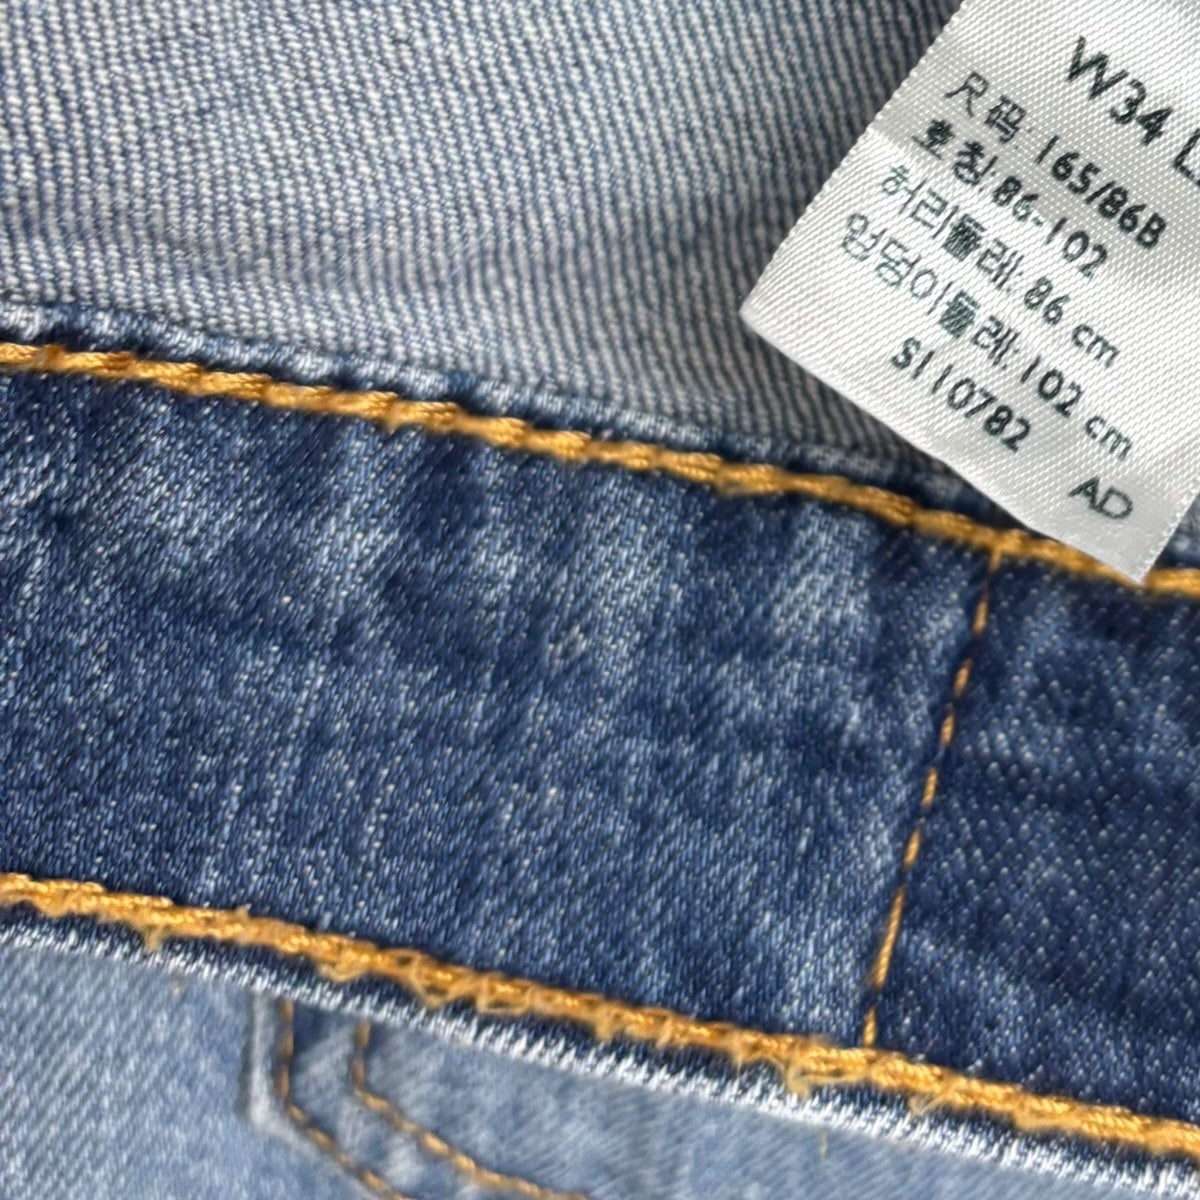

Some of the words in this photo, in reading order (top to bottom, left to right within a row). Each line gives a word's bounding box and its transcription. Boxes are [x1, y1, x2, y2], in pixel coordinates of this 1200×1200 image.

[1066, 34, 1174, 147] W34
[1035, 134, 1168, 251] 165/86B
[1023, 276, 1072, 327] 86
[1070, 323, 1122, 369] cm
[889, 335, 1033, 454] S110782
[1019, 354, 1085, 418] 102
[1084, 414, 1134, 461] cm
[1067, 475, 1135, 521] AD
